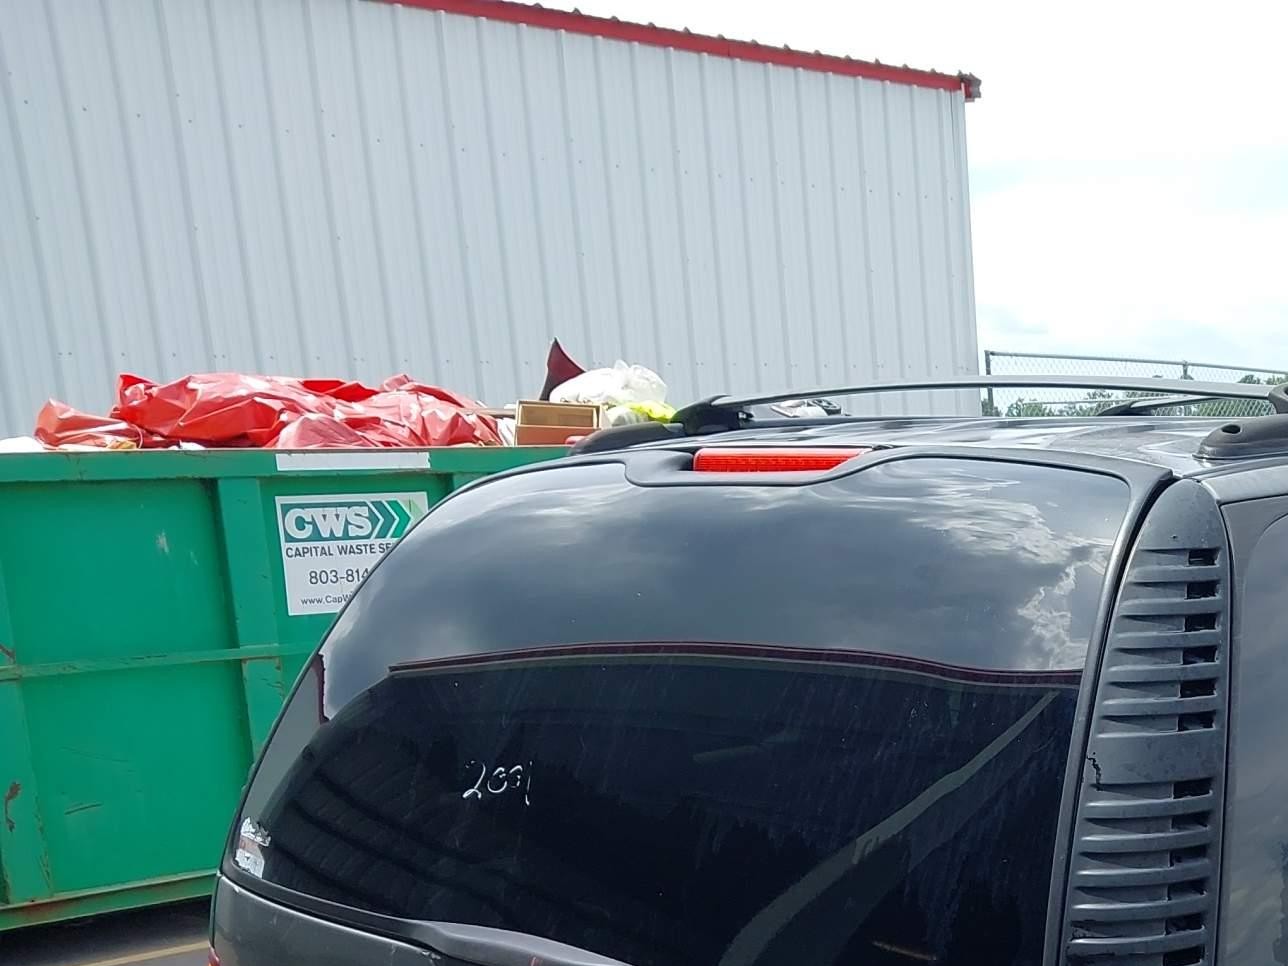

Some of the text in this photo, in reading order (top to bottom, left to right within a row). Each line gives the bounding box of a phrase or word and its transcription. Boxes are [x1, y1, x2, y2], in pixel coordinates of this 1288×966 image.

[284, 506, 372, 539] CWS
[285, 544, 334, 558] CAPITAL
[337, 543, 377, 555] WASTE
